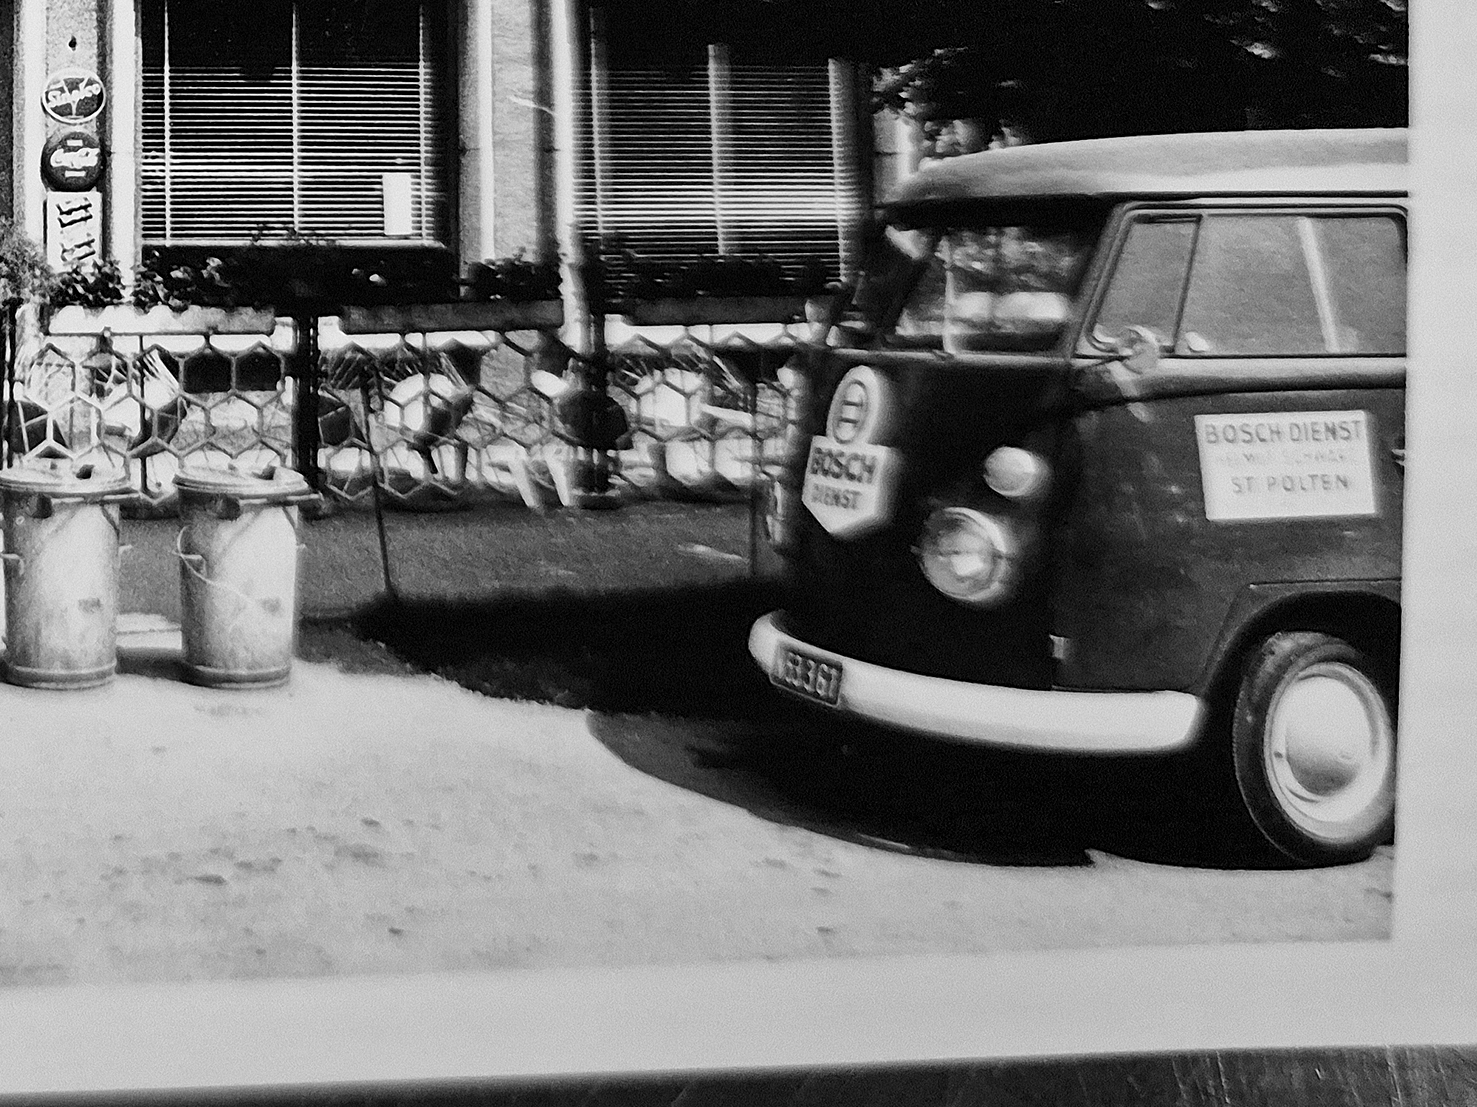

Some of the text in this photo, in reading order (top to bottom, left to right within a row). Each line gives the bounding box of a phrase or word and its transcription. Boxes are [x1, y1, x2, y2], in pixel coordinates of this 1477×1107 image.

[1205, 420, 1361, 444] BOSCH DIENST
[811, 447, 877, 485] BOSCH
[811, 483, 863, 510] DIENST
